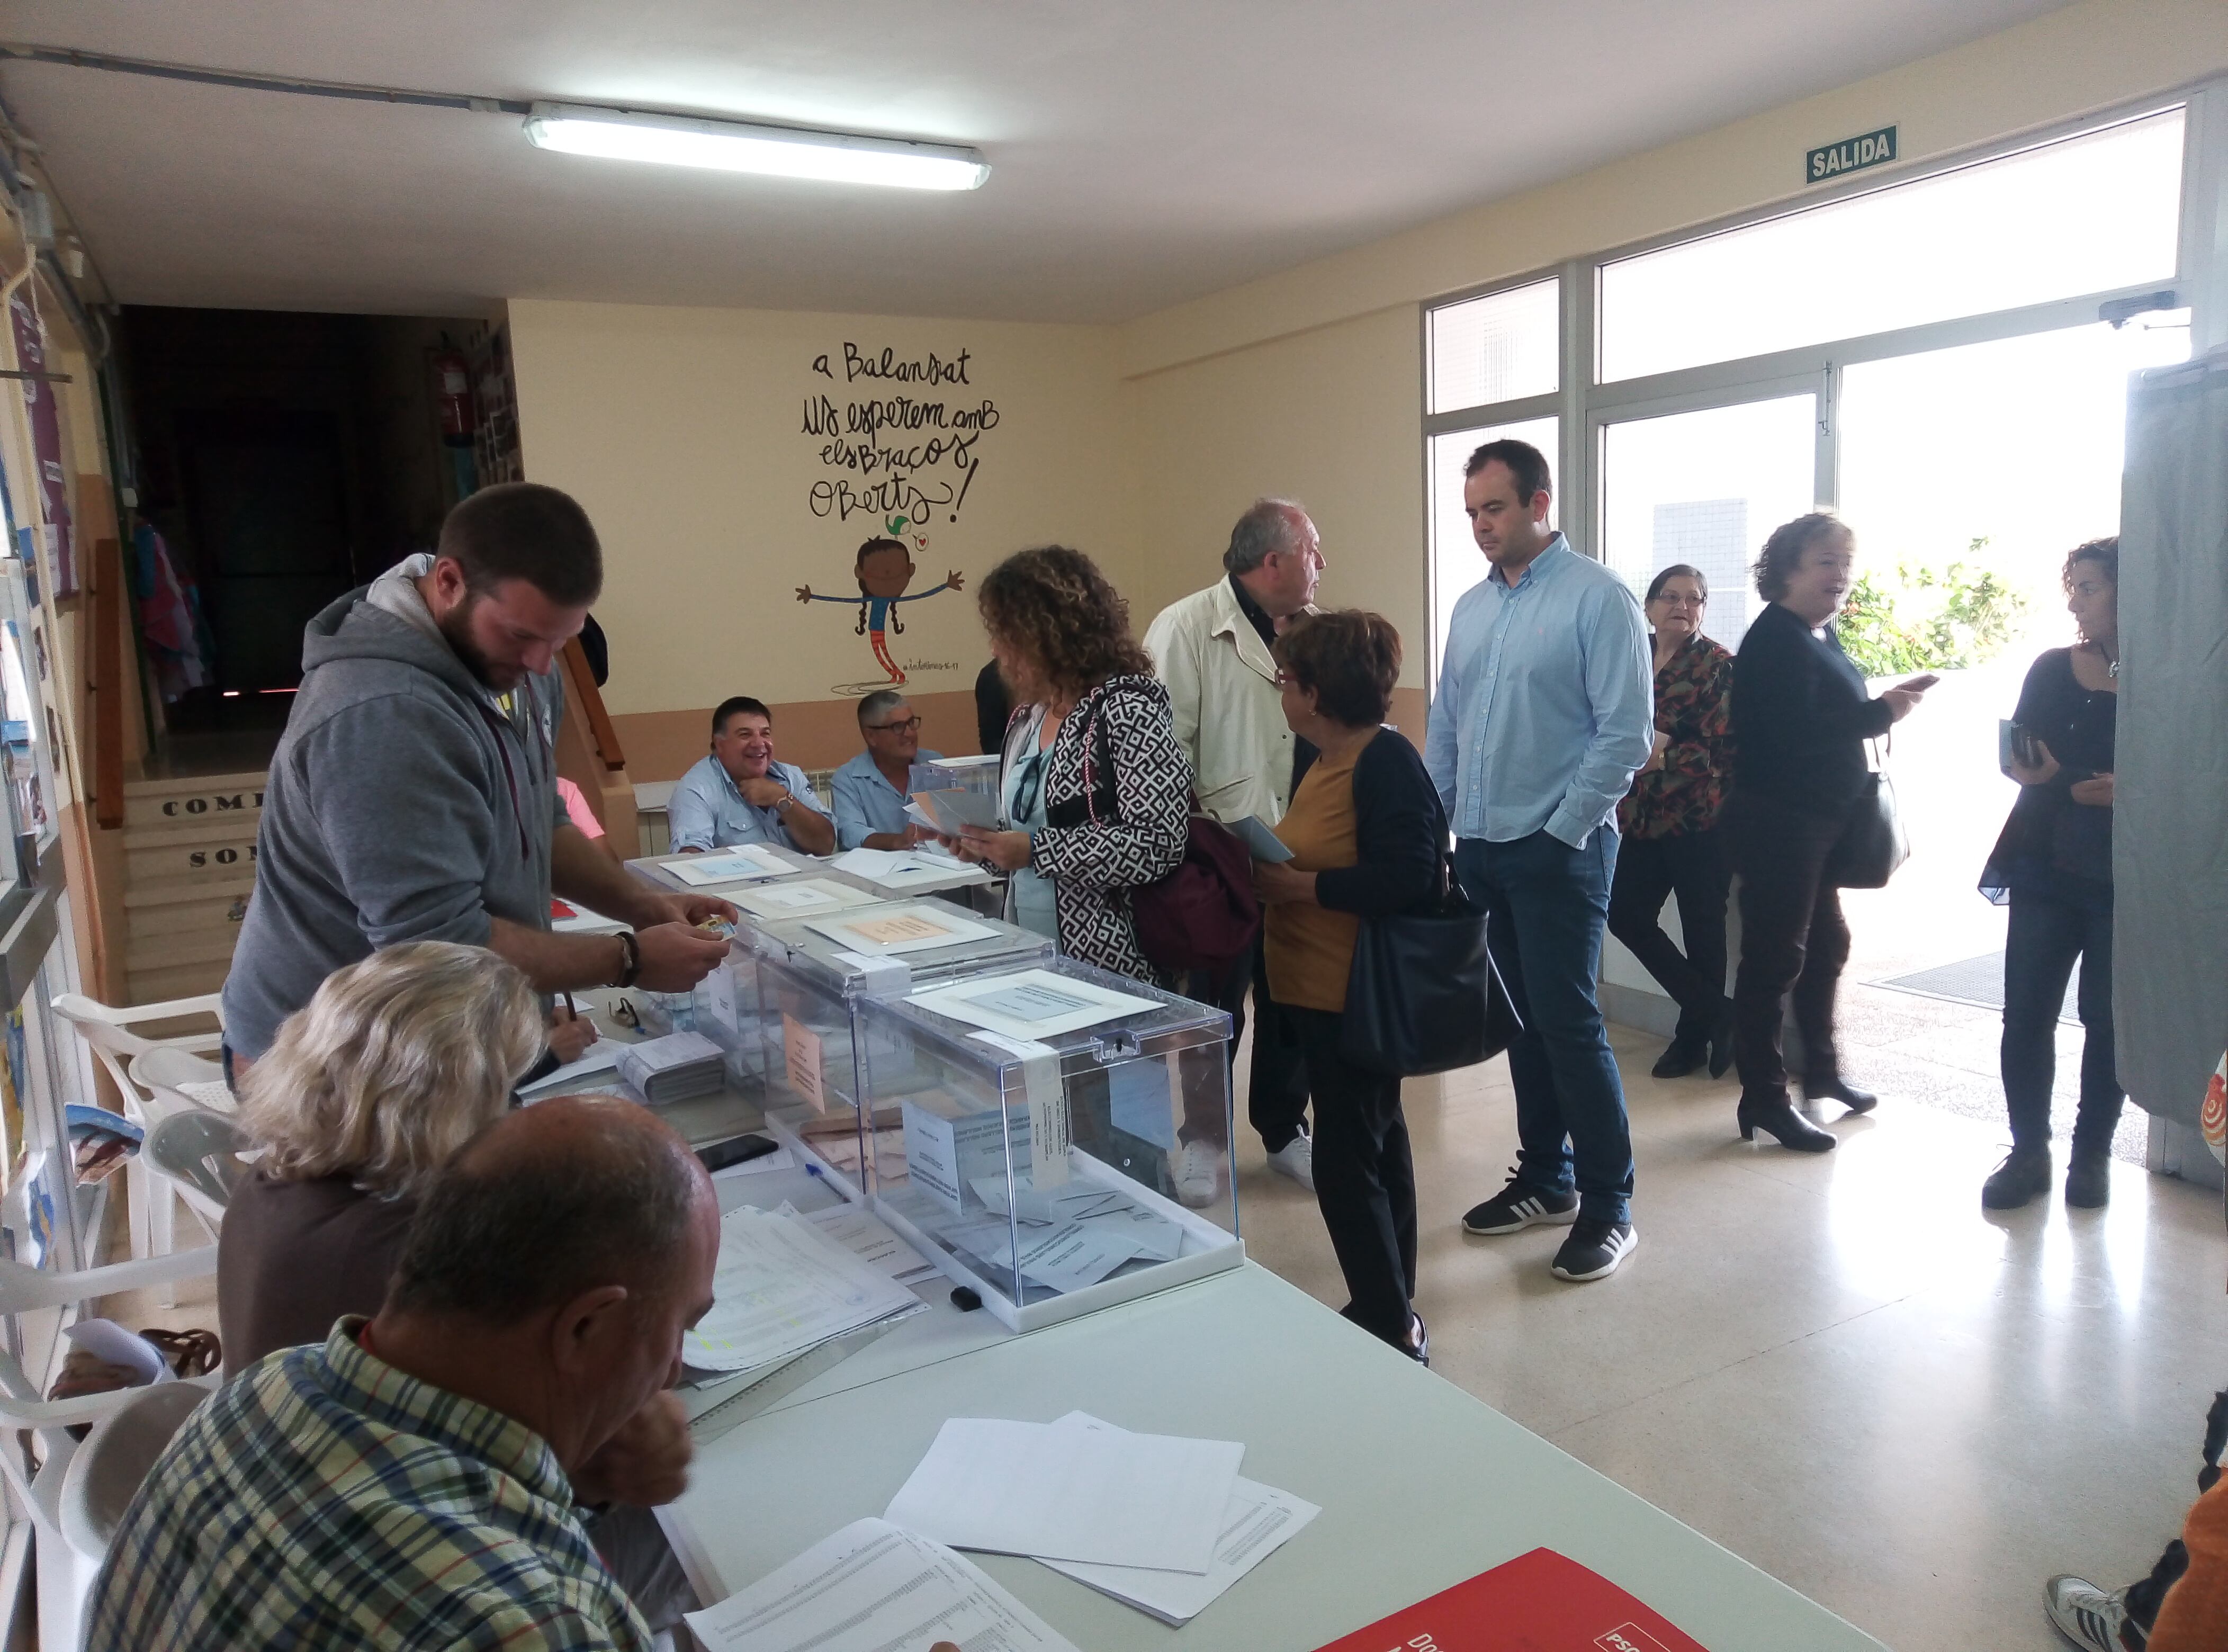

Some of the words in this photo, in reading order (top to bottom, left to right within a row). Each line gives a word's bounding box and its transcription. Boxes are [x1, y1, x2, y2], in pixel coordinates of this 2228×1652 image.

[1812, 133, 1890, 177] SALIDA
[843, 342, 971, 387] Balansat
[845, 396, 949, 450] esperem
[1406, 1633, 1444, 1652] Do
